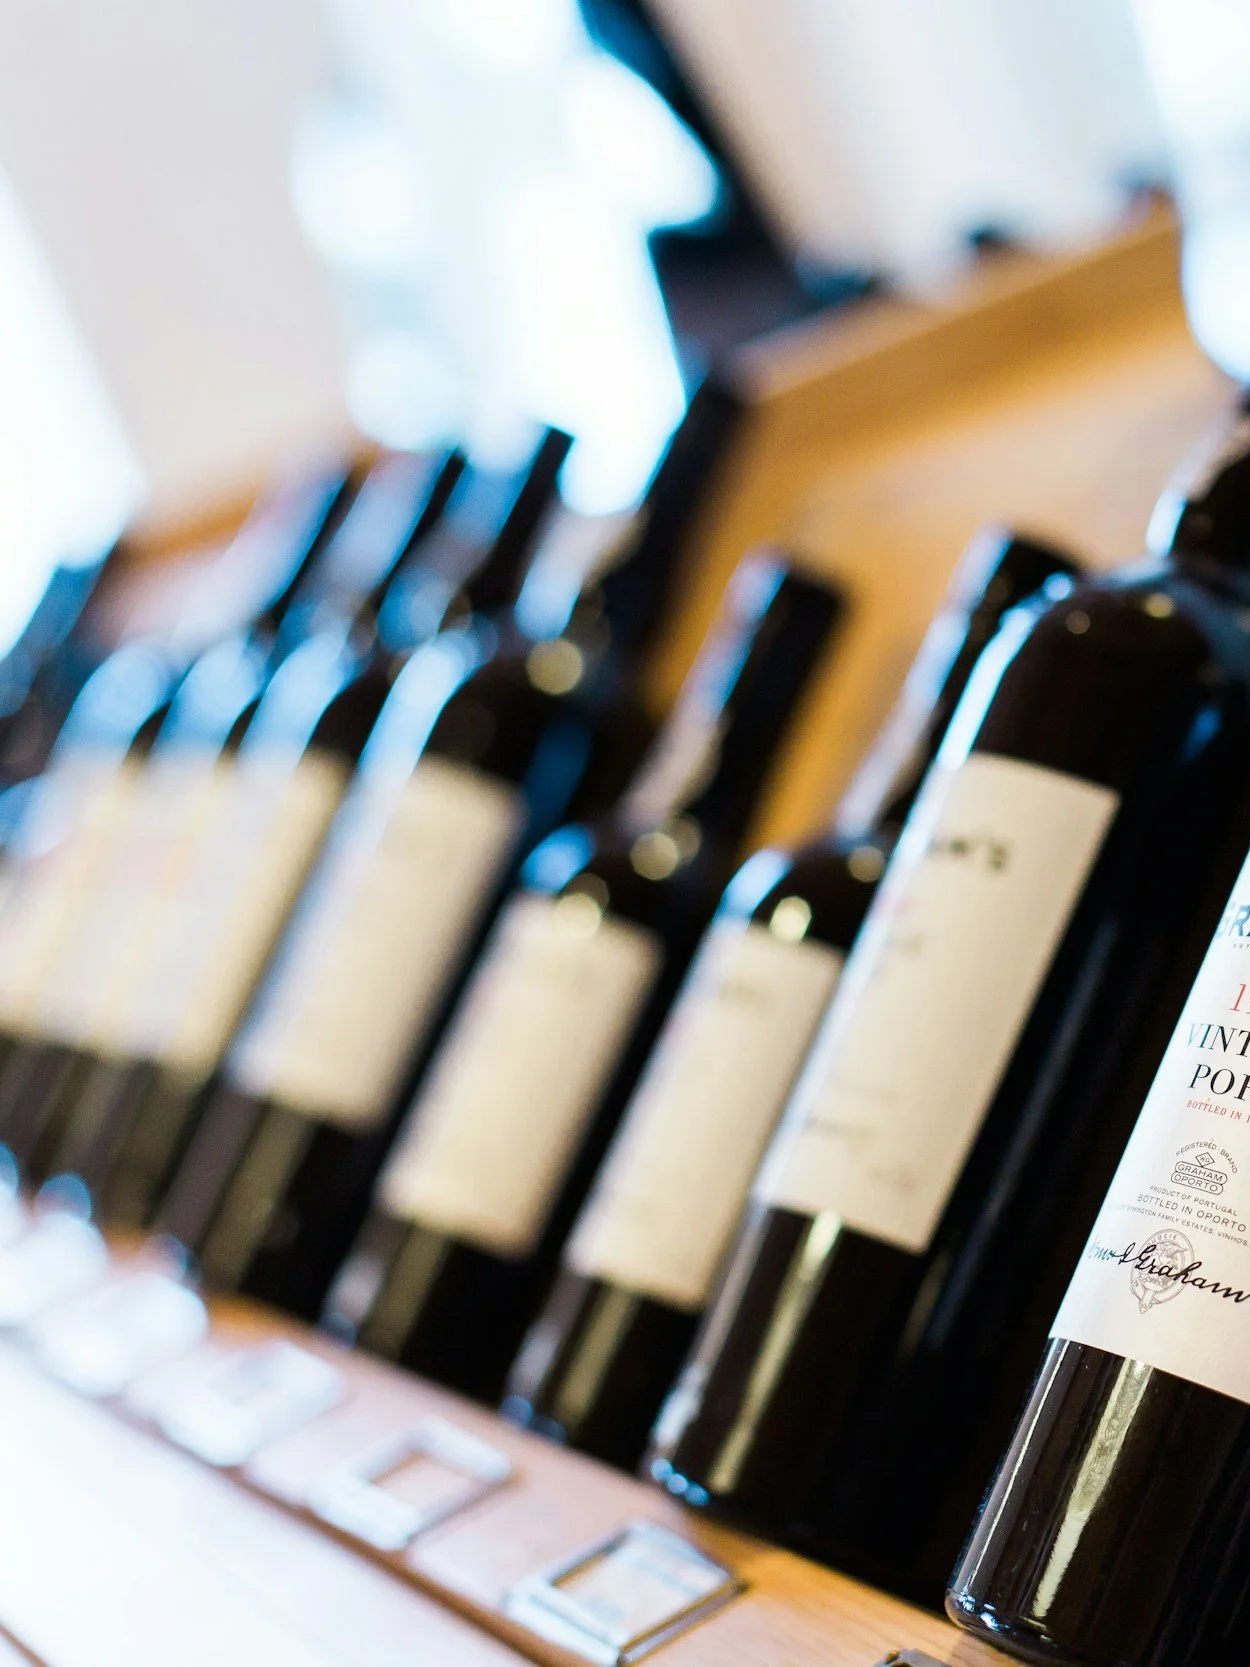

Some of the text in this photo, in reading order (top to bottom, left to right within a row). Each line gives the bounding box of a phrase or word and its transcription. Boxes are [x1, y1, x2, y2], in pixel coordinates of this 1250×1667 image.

[1186, 1099, 1227, 1116] BOTTLED
[1230, 1110, 1242, 1120] IN
[1176, 1141, 1238, 1174] REGISTERED BRAND
[1174, 1174, 1218, 1192] OPORTO
[1177, 1163, 1223, 1182] GRAHAM
[1149, 1185, 1238, 1217] PRODUCT OF PORTUGAL
[1137, 1193, 1247, 1232] BOTTLED IN OPORTO
[1158, 1213, 1179, 1223] FAMILY
